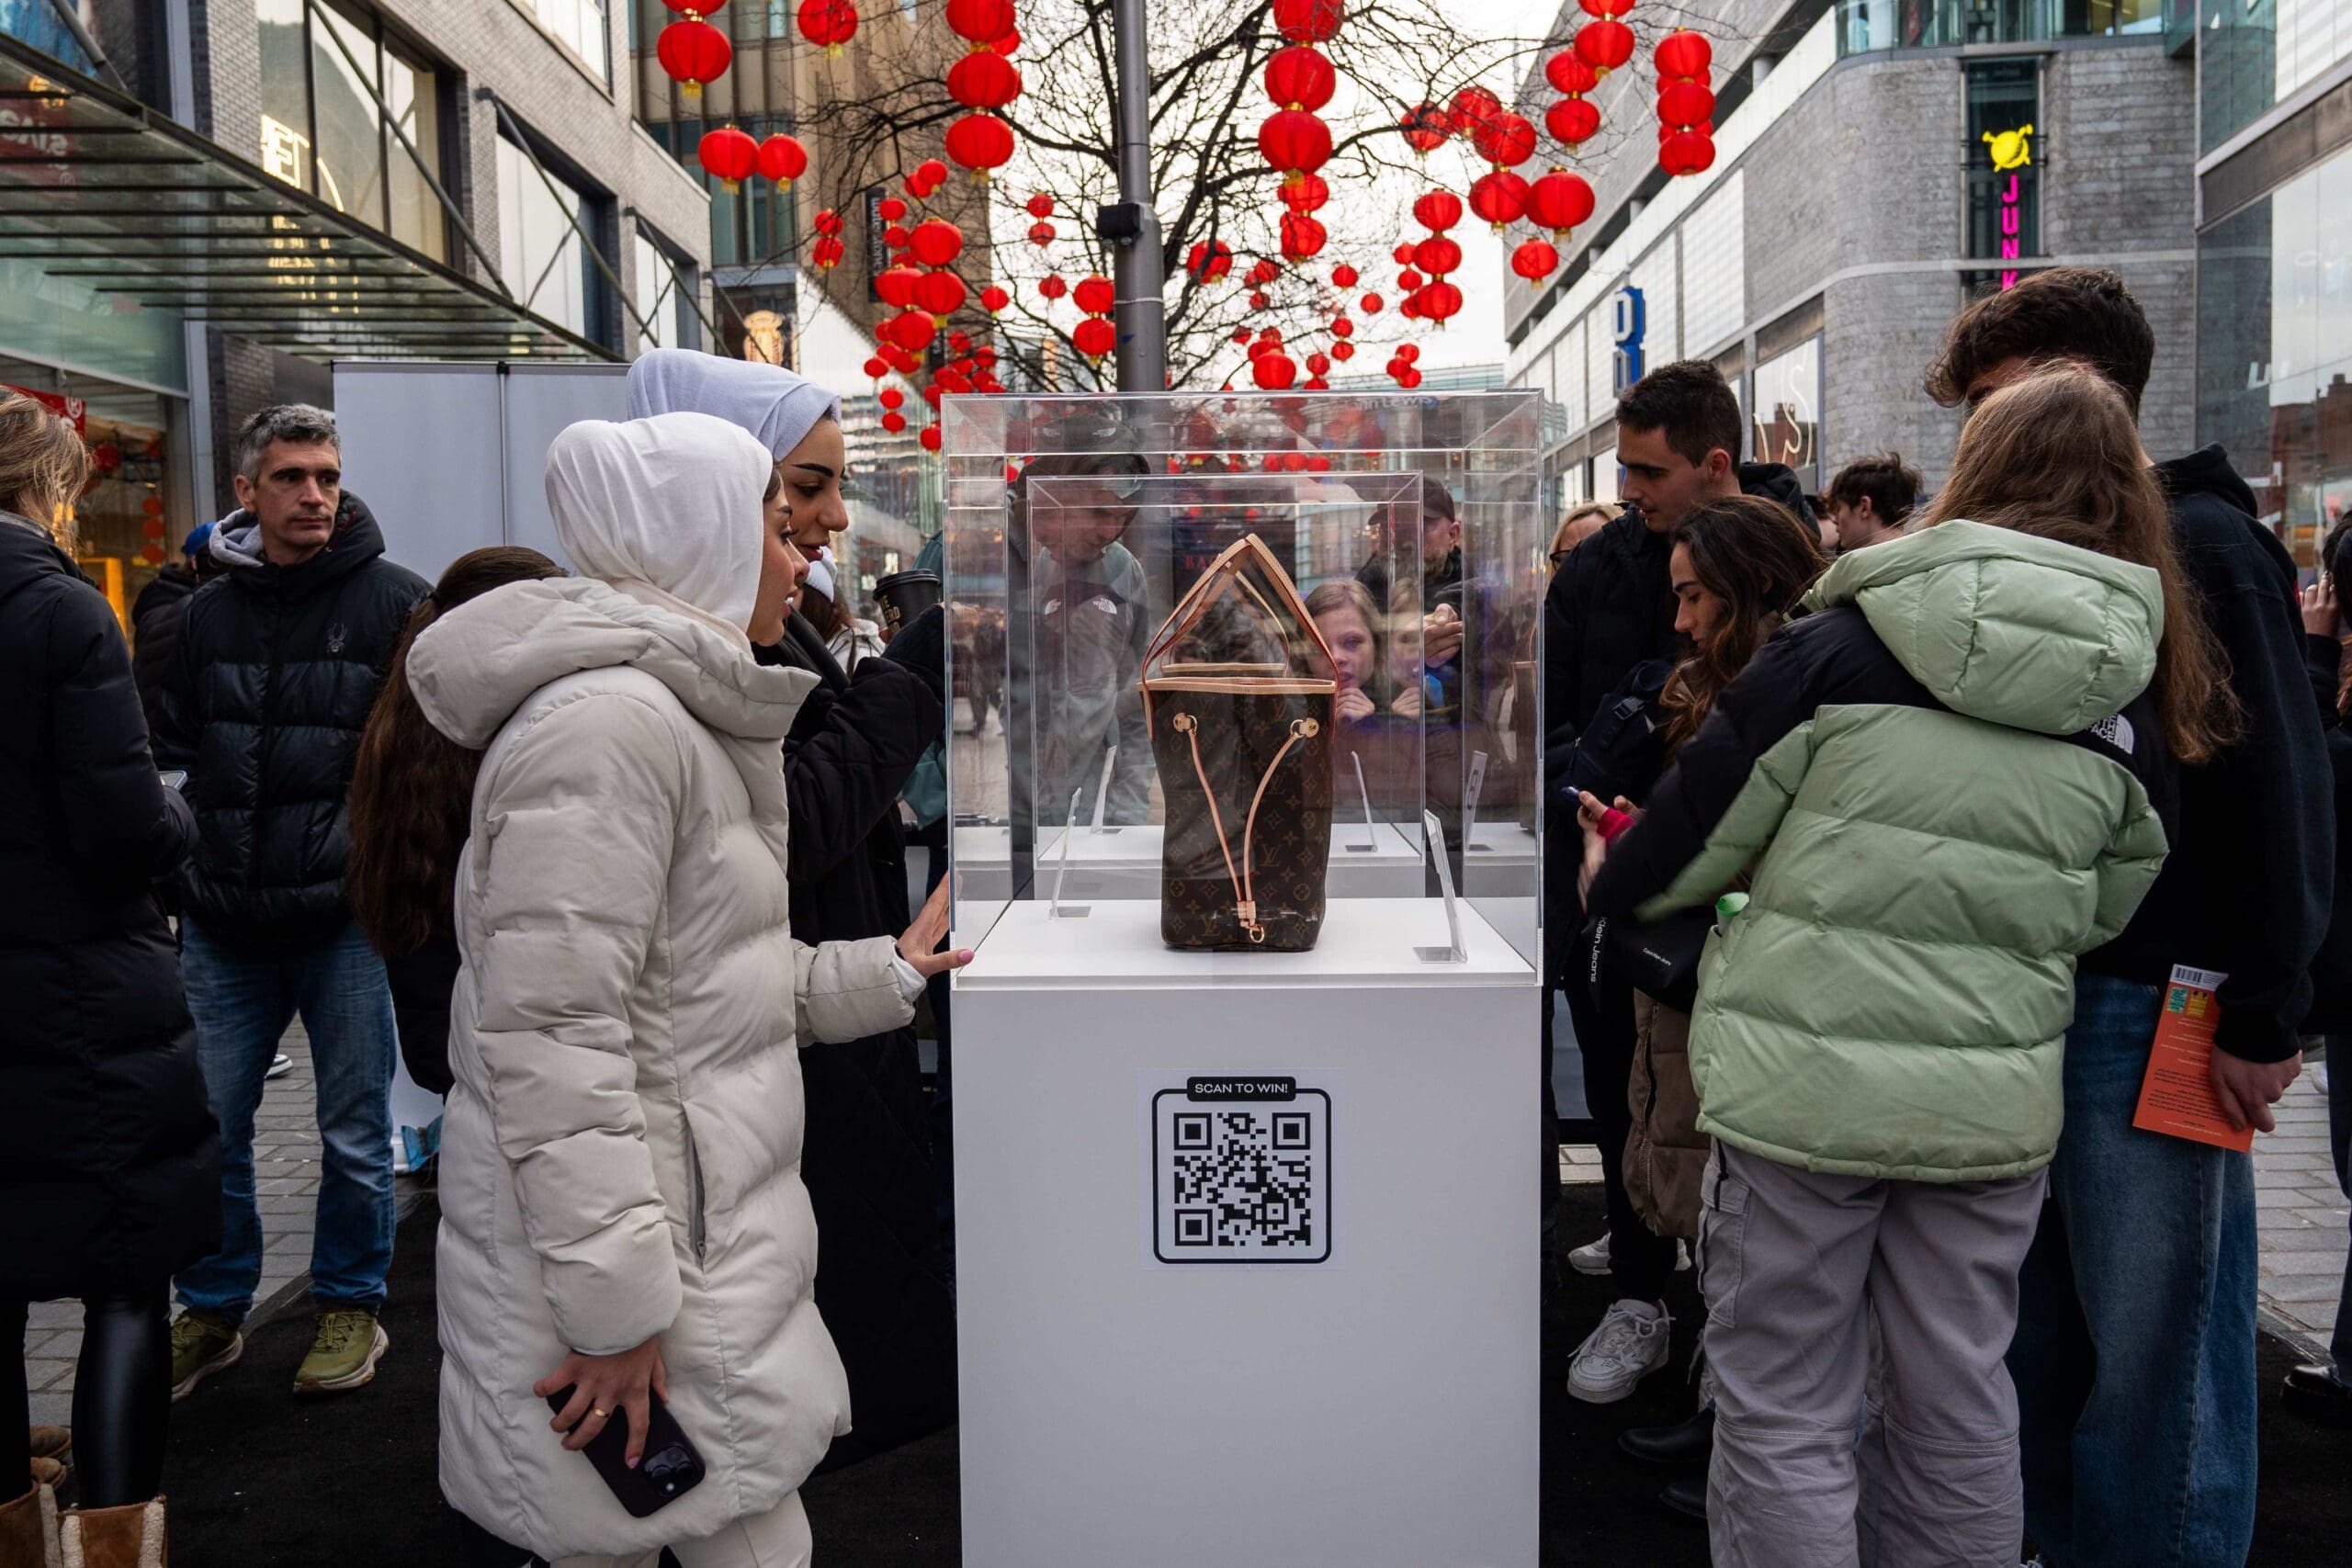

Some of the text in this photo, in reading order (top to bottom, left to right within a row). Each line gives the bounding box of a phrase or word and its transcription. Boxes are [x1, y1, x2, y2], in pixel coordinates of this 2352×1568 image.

[2090, 723, 2115, 743] ACE
[1590, 917, 1608, 983] Klein Jeans
[1194, 1083, 1288, 1093] SCAN TO WIN!
